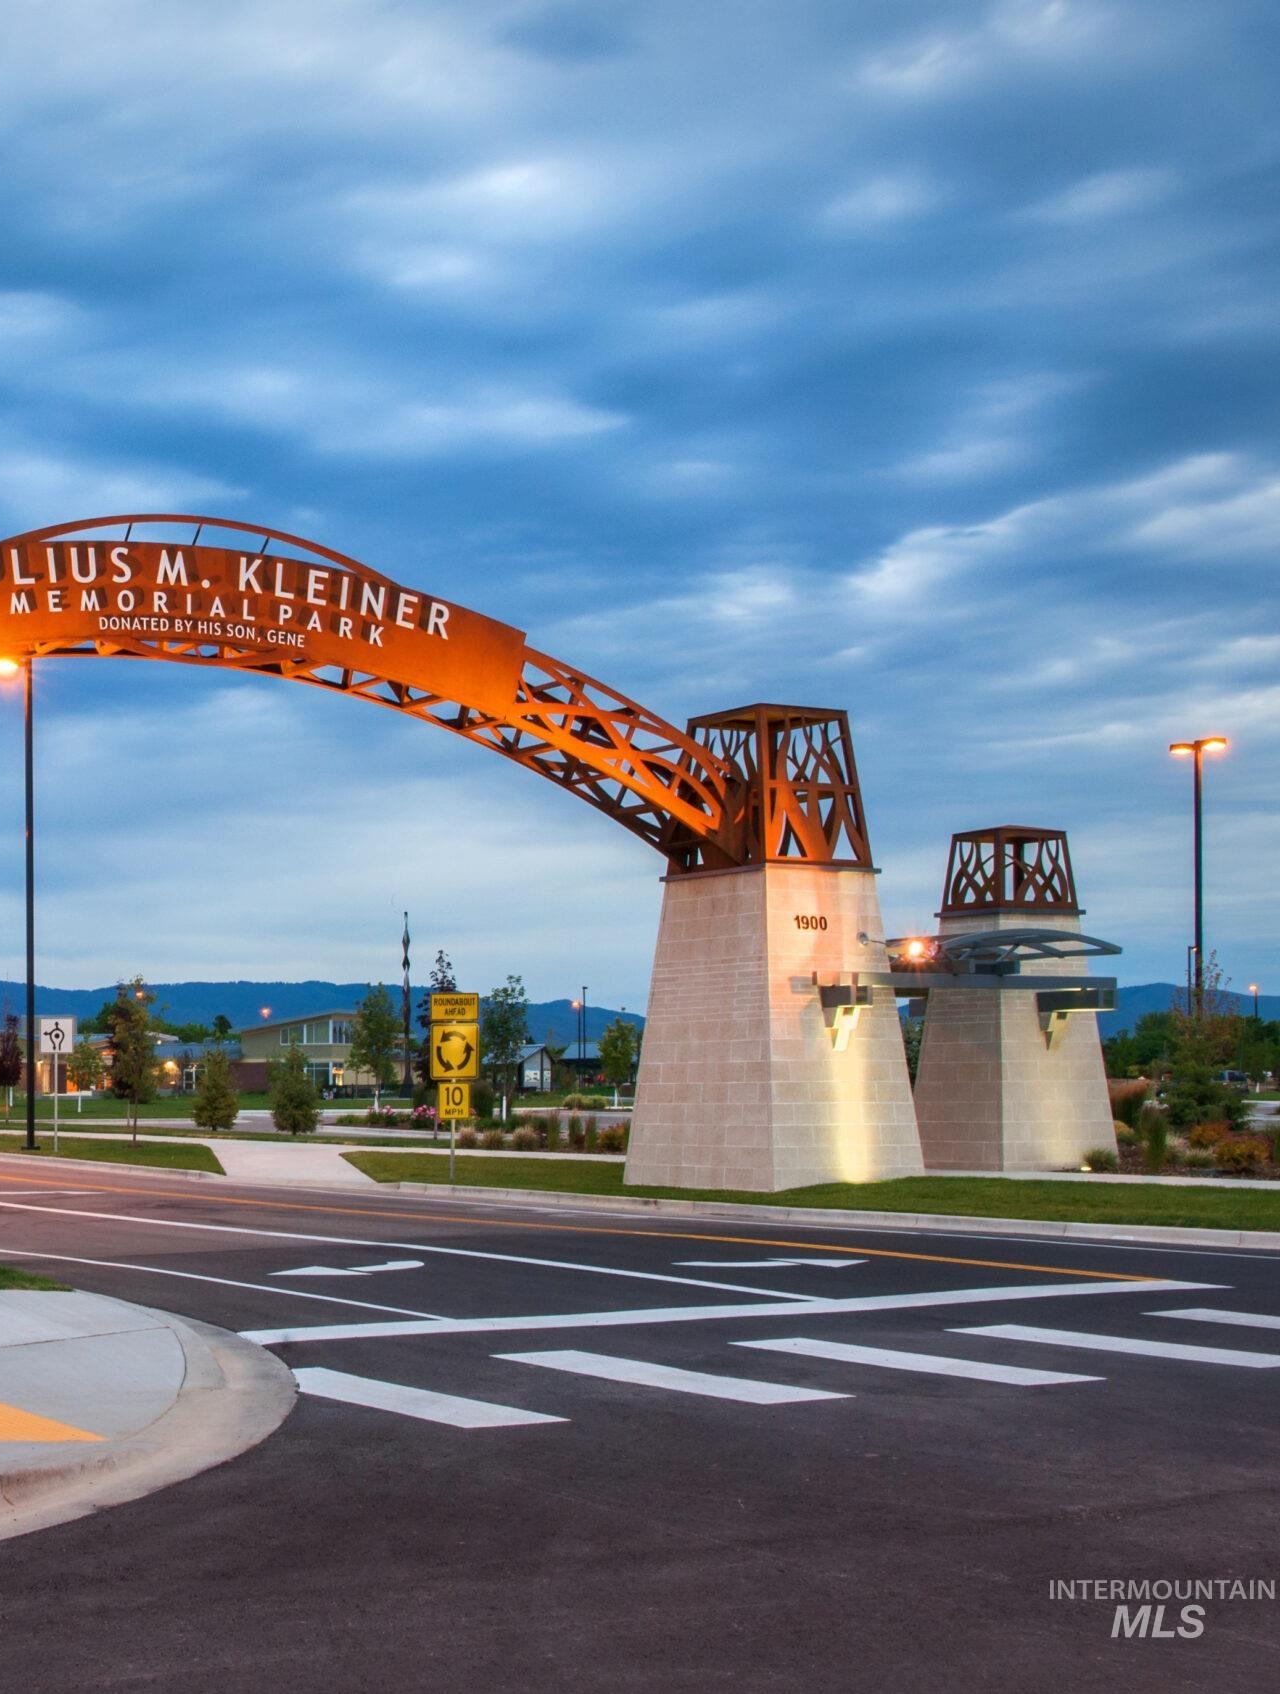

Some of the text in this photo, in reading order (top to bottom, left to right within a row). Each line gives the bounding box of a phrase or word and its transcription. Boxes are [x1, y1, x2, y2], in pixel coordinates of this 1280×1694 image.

[156, 549, 210, 589] M.
[238, 556, 449, 640] KLEINER
[10, 589, 385, 648] MEMORIAL PARK
[99, 616, 306, 648] DONATED BY HIS SON, GENE
[794, 915, 828, 931] 1900
[433, 997, 476, 1007] ROUNDABOUT
[444, 1007, 466, 1017] AHEAD
[444, 1086, 464, 1107] 10
[444, 1108, 464, 1116] MPH
